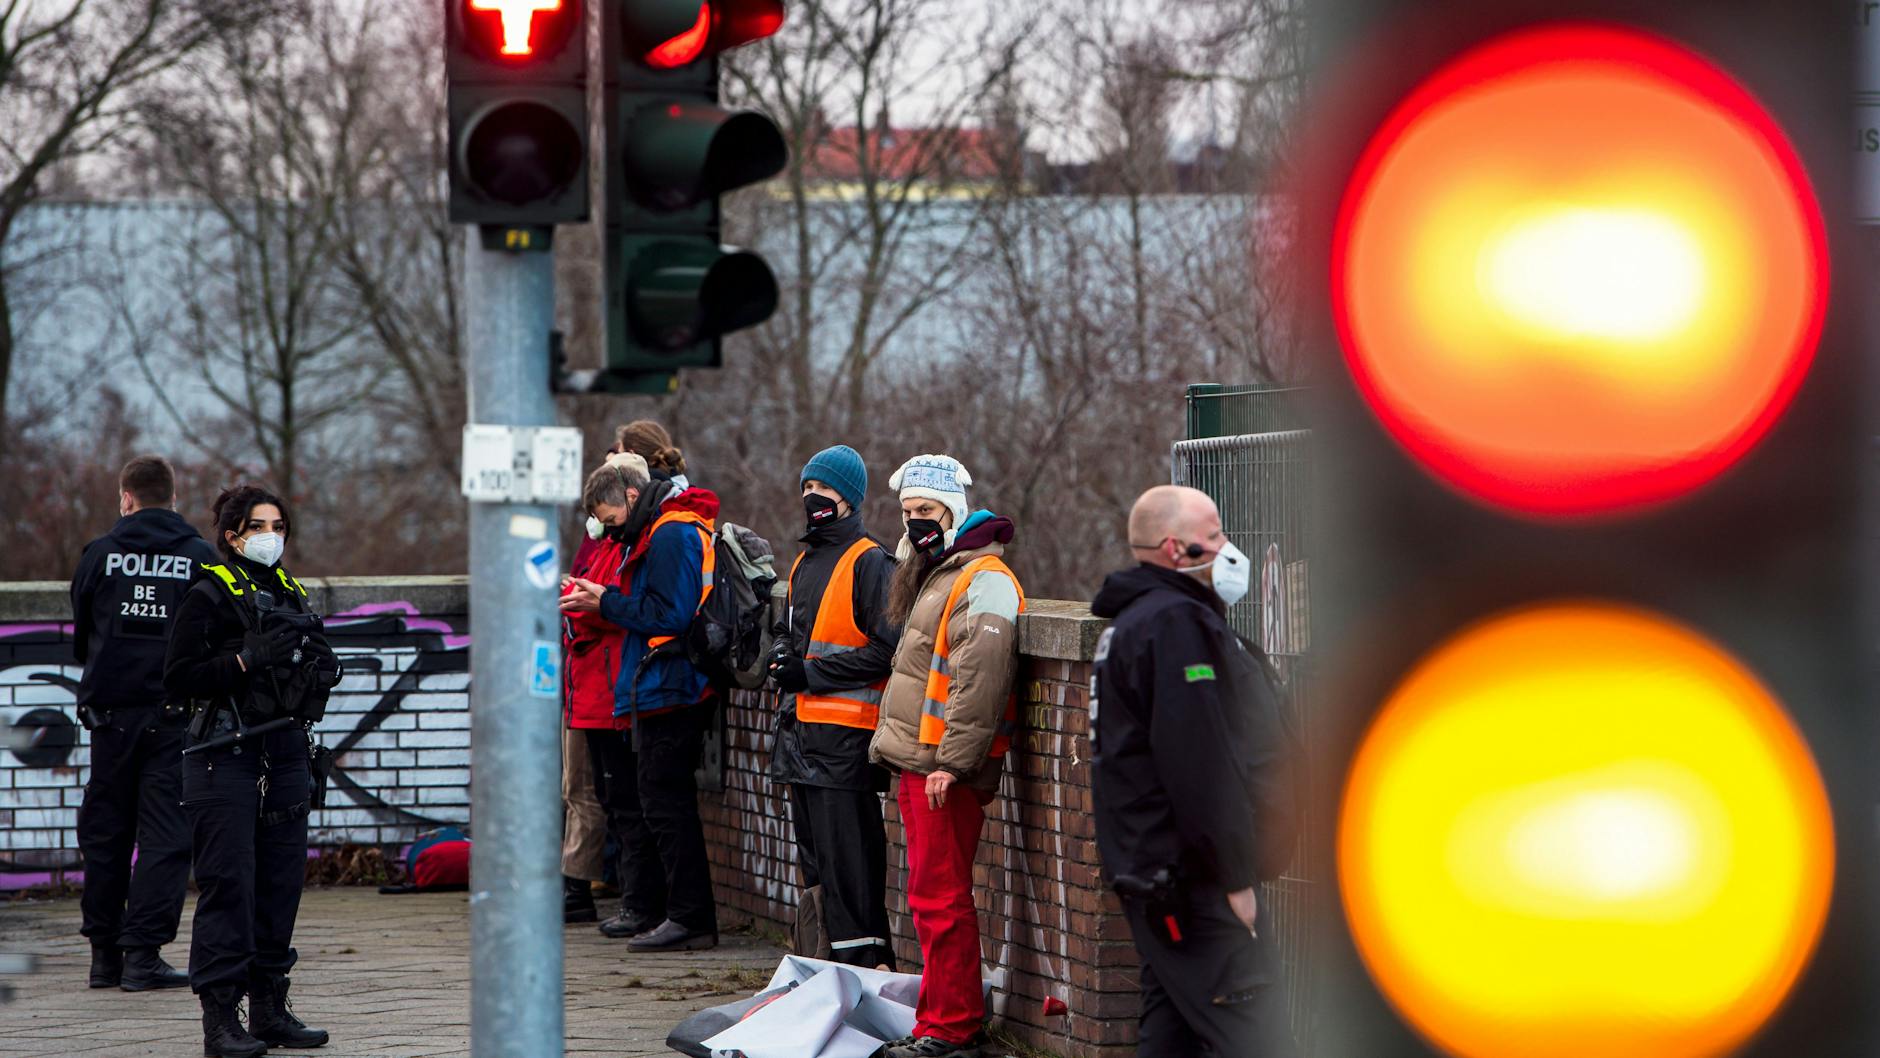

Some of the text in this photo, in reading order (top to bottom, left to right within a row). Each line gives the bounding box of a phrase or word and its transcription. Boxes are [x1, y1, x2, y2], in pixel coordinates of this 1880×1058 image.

[557, 448, 578, 470] 21
[479, 469, 512, 490] 100
[105, 552, 193, 580] POLIZEI
[133, 584, 156, 601] BE
[120, 601, 168, 619] 24211
[983, 625, 1000, 634] FILA
